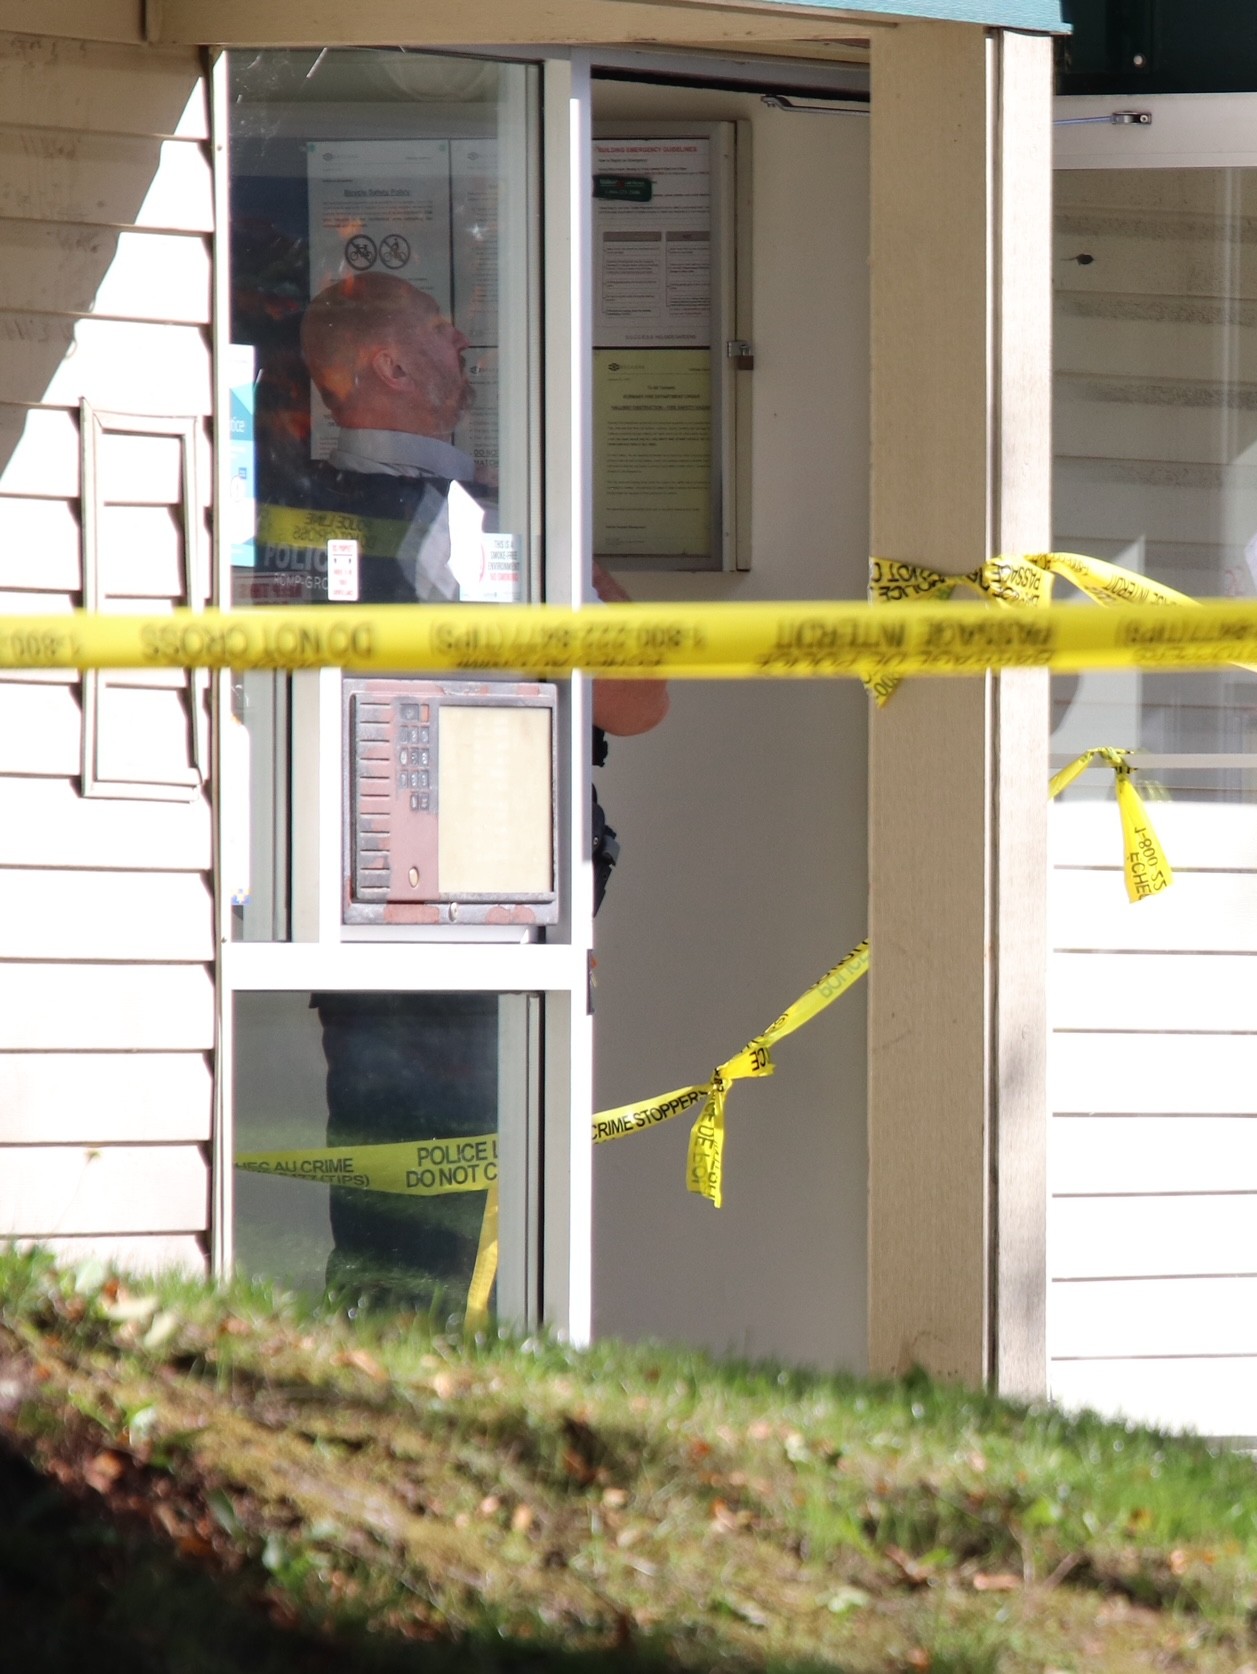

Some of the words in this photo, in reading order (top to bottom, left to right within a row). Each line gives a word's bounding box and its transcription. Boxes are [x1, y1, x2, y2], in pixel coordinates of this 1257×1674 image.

[264, 544, 328, 573] POLIC
[140, 624, 249, 661] CROSS
[262, 623, 321, 660] NOT
[328, 622, 374, 660] DO
[776, 621, 907, 650] INTERDIT
[923, 621, 1055, 649] PASSAGE
[300, 1158, 354, 1174] CRIME
[417, 1142, 488, 1168] POLICE
[406, 1169, 436, 1188] DO
[439, 1163, 480, 1187] NOT
